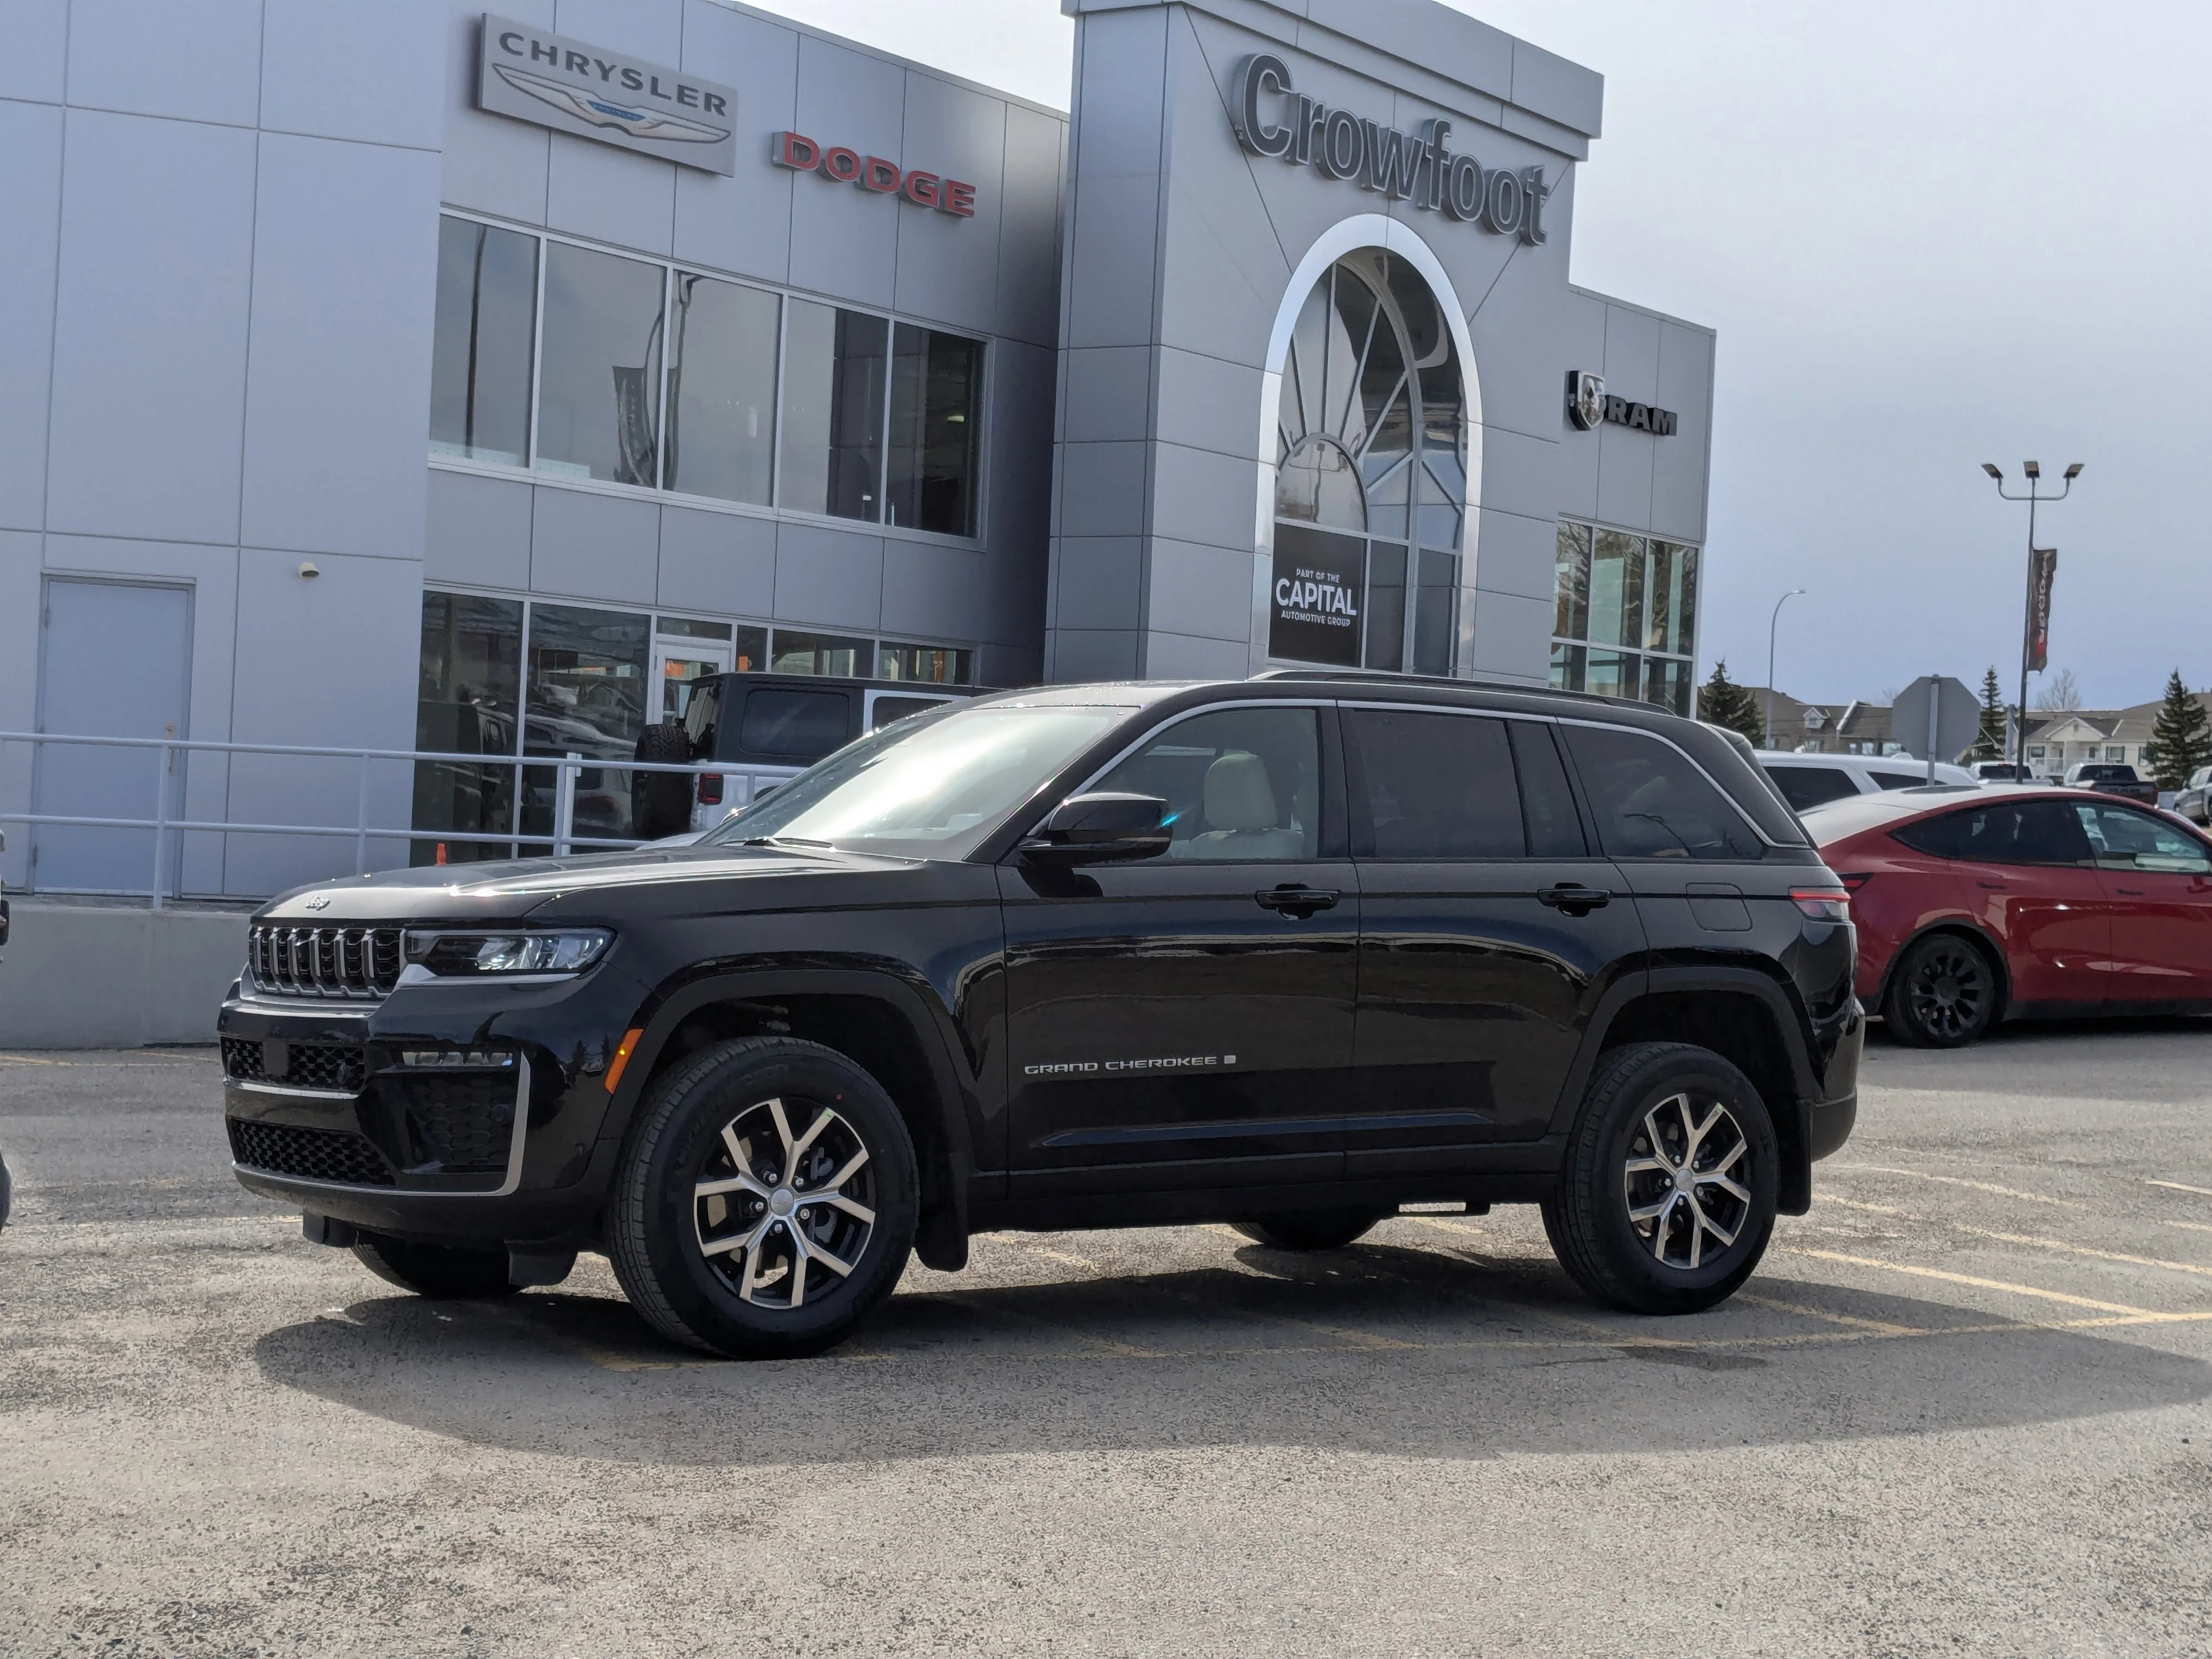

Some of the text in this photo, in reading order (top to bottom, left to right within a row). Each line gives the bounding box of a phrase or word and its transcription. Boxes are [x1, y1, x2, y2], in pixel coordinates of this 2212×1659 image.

[498, 30, 728, 117] CHRYSLER
[1233, 53, 1549, 246] Crowfoot
[775, 131, 977, 218] DODGE
[1606, 394, 1678, 437] RAM
[1296, 568, 1340, 583] PART OF THE
[1276, 578, 1357, 616] CAPITAL
[1281, 610, 1351, 627] AUTOMOTIVE GROUP
[1024, 1056, 1217, 1075] GRAND CHEROKEE
